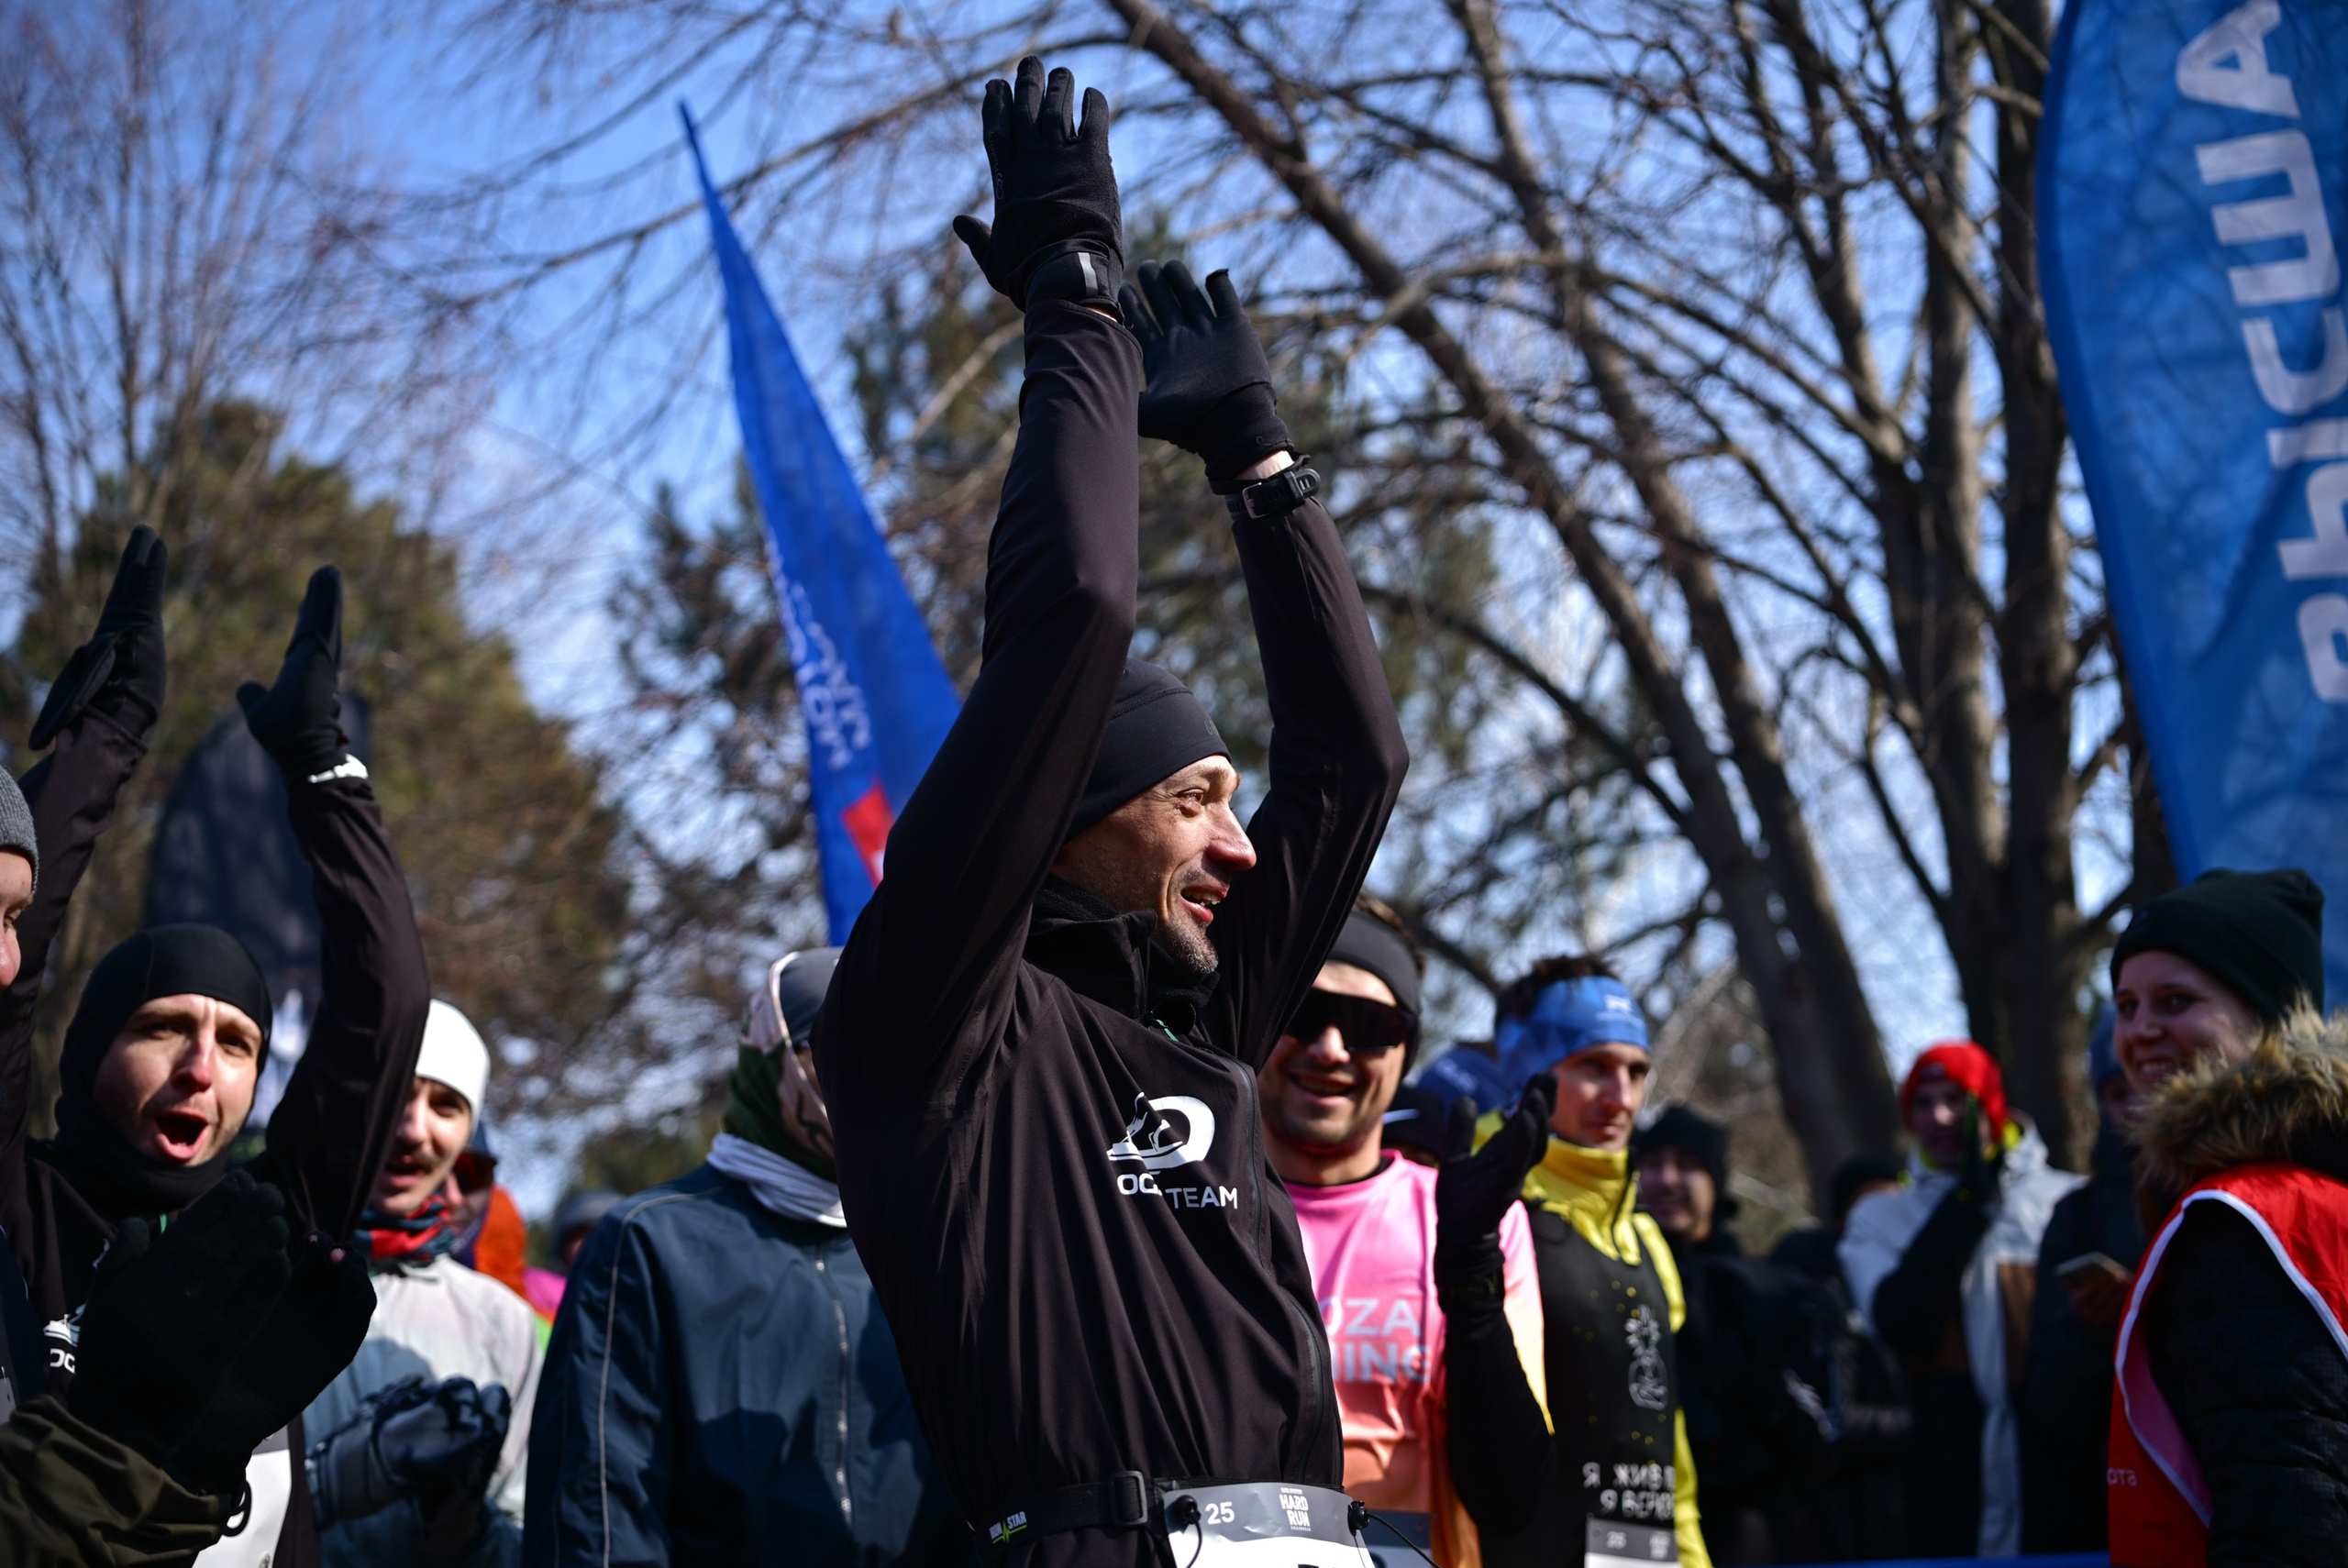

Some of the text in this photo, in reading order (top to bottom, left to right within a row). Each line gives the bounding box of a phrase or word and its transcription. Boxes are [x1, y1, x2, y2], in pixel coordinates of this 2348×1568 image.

[1165, 1185, 1237, 1209] TEAM
[1317, 1295, 1421, 1337] OZA
[1332, 1342, 1429, 1384] ING
[1582, 1462, 1600, 1488] Я
[1205, 1502, 1235, 1525] 25
[1279, 1494, 1309, 1511] HARD
[1600, 1488, 1618, 1516] Я
[1006, 1510, 1027, 1529] STAR
[1286, 1509, 1311, 1527] RUN
